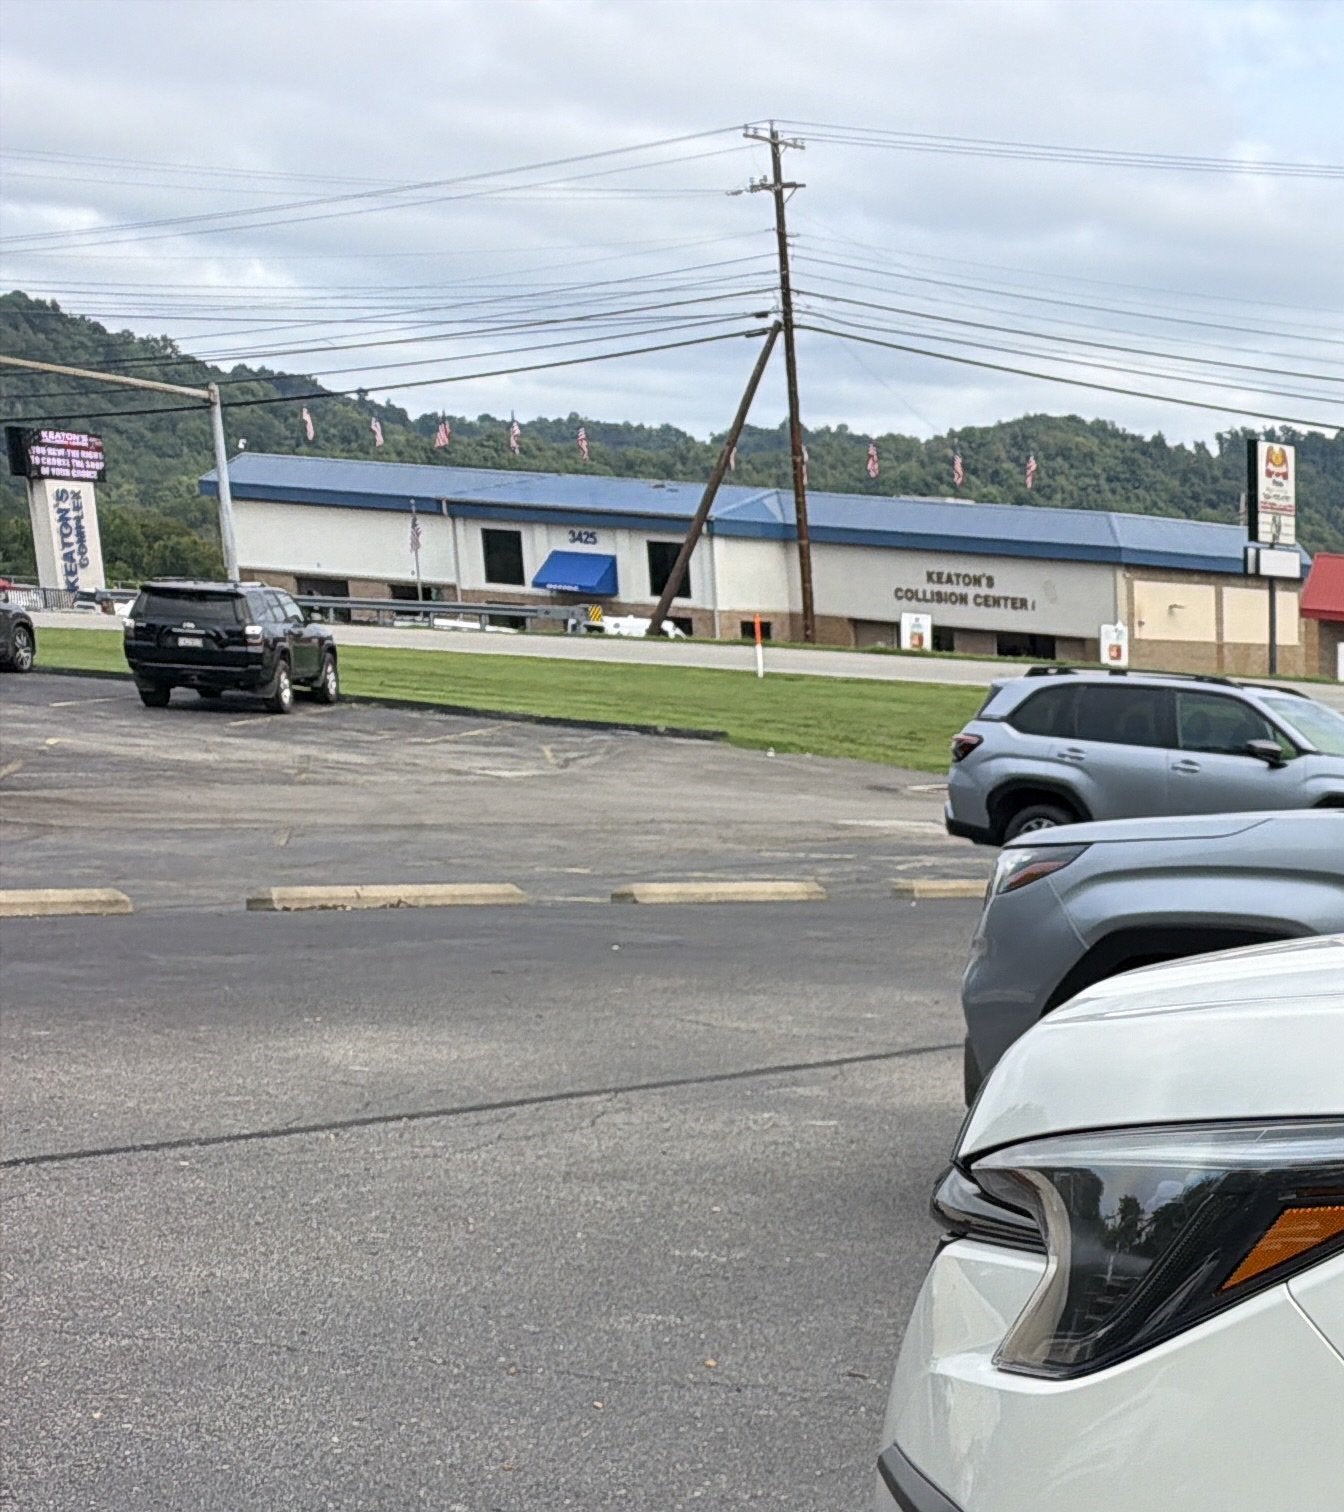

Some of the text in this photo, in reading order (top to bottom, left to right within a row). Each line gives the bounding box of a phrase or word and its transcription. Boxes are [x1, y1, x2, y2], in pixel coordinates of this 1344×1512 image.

[54, 488, 80, 592] KEATON'S
[568, 529, 598, 545] 3425
[926, 570, 995, 589] KEATON'S
[894, 587, 969, 606] COLLISION
[973, 593, 1028, 611] CENTER
